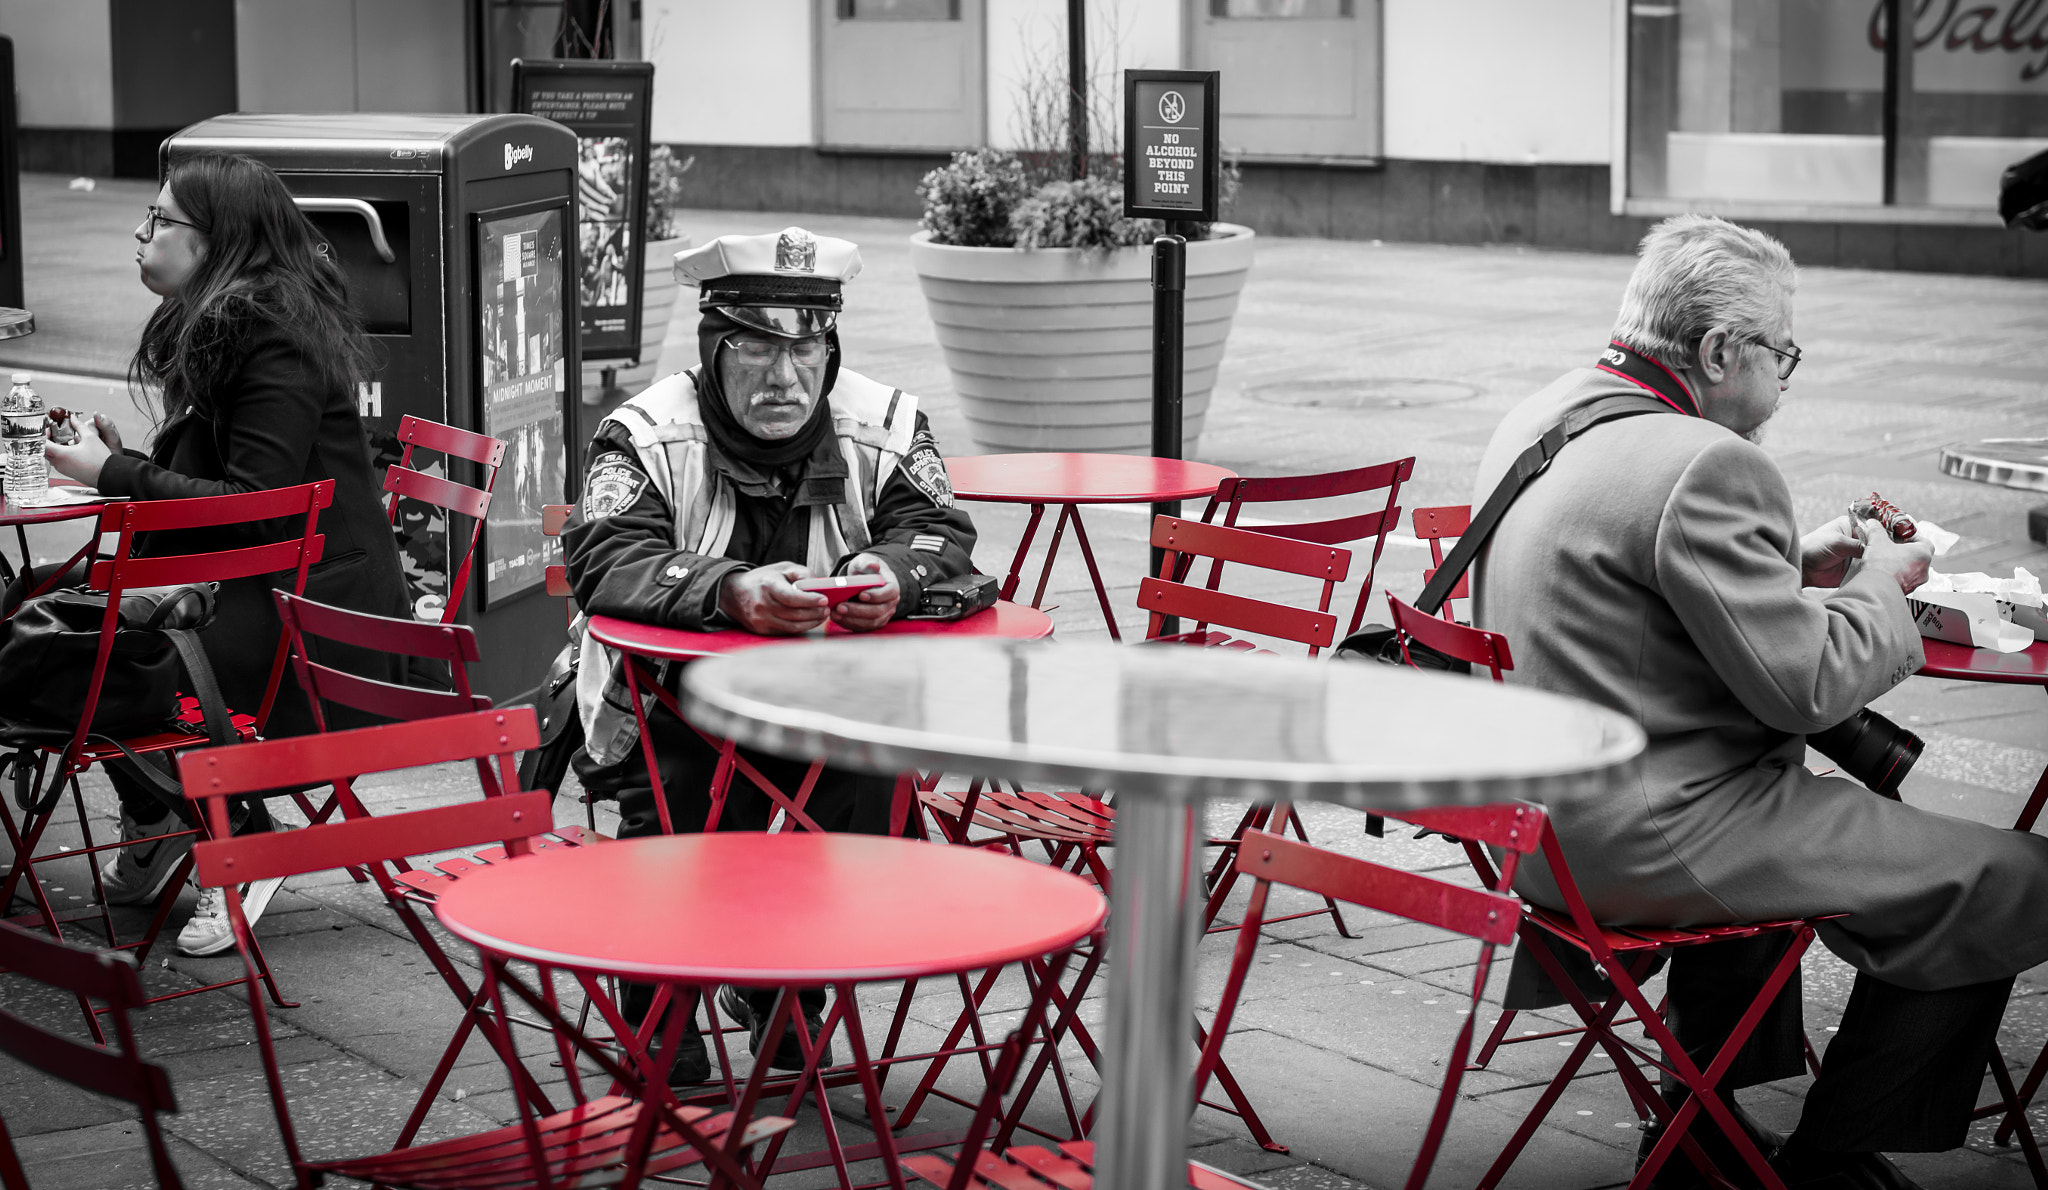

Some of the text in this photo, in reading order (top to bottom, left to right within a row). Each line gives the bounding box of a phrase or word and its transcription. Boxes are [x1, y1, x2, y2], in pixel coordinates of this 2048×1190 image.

[1163, 133, 1179, 144] NO
[504, 142, 534, 171] Bigbelly
[1145, 145, 1198, 158] ALCOHOL
[1148, 157, 1194, 170] BEYOND
[1157, 170, 1186, 182] THIS
[1153, 182, 1190, 195] POINT
[522, 240, 535, 251] TIMES
[493, 382, 524, 404] MIDNIGHT
[524, 374, 553, 396] MOMENT
[912, 448, 935, 462] POLICE
[601, 466, 633, 478] POLICE
[919, 480, 937, 496] CITY
